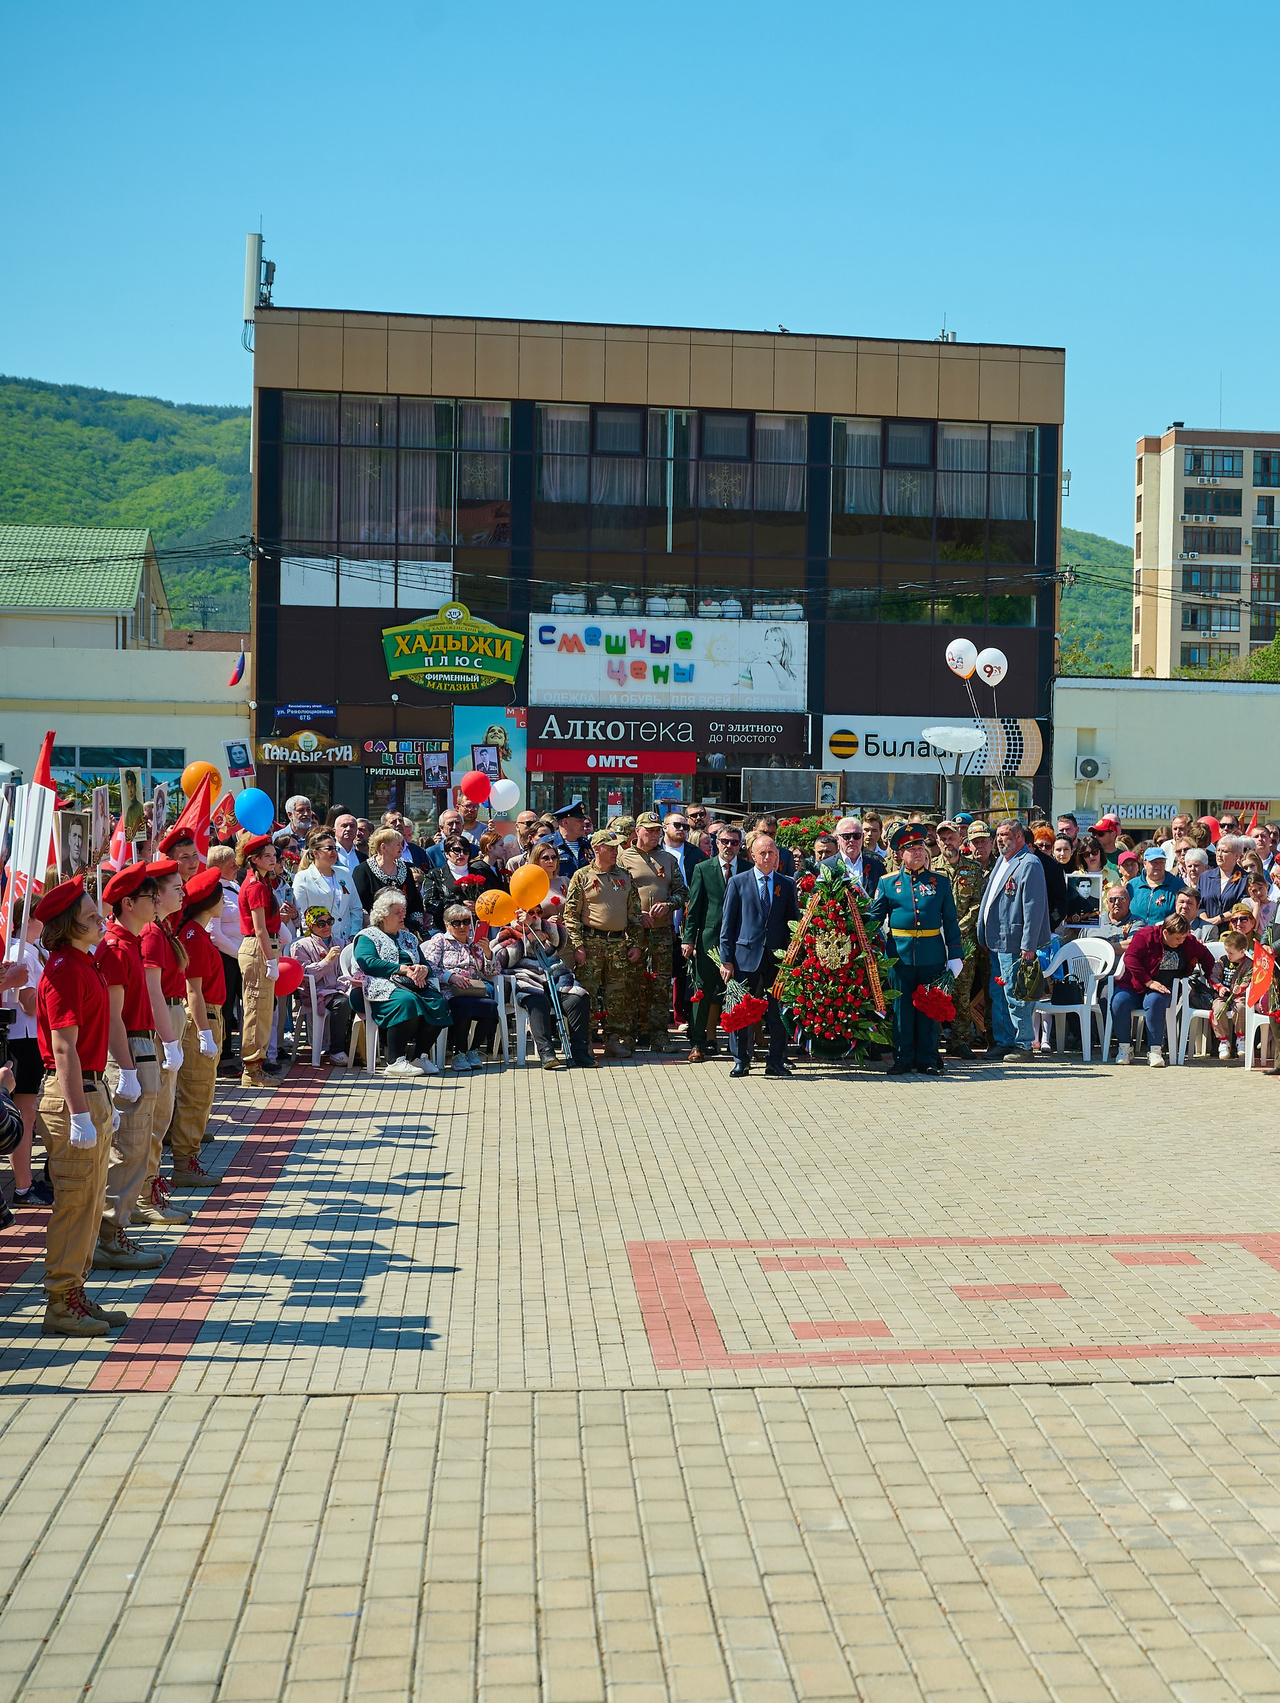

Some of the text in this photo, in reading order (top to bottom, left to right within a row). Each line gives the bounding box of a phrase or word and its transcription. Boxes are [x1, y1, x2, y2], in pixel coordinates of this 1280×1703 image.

[393, 634, 513, 662] ХАДЫЖИ
[425, 672, 480, 682] ФИРМЕННЫЙ
[426, 680, 479, 691] МАГАЗИН
[609, 694, 618, 703] И
[620, 694, 661, 705] ОБУВЬ
[671, 695, 695, 706] ДЛЯ
[699, 694, 731, 706] ВСЕЙ
[744, 697, 786, 707] СЕМЬИ
[709, 722, 784, 733] От элитного
[708, 734, 777, 744] до простого
[364, 740, 450, 752] СМЕШНЫЕ
[262, 743, 353, 763] ТАНДЫР-ТУН
[599, 755, 638, 768] МТС
[1222, 800, 1269, 810] ПРОДУКТЫ
